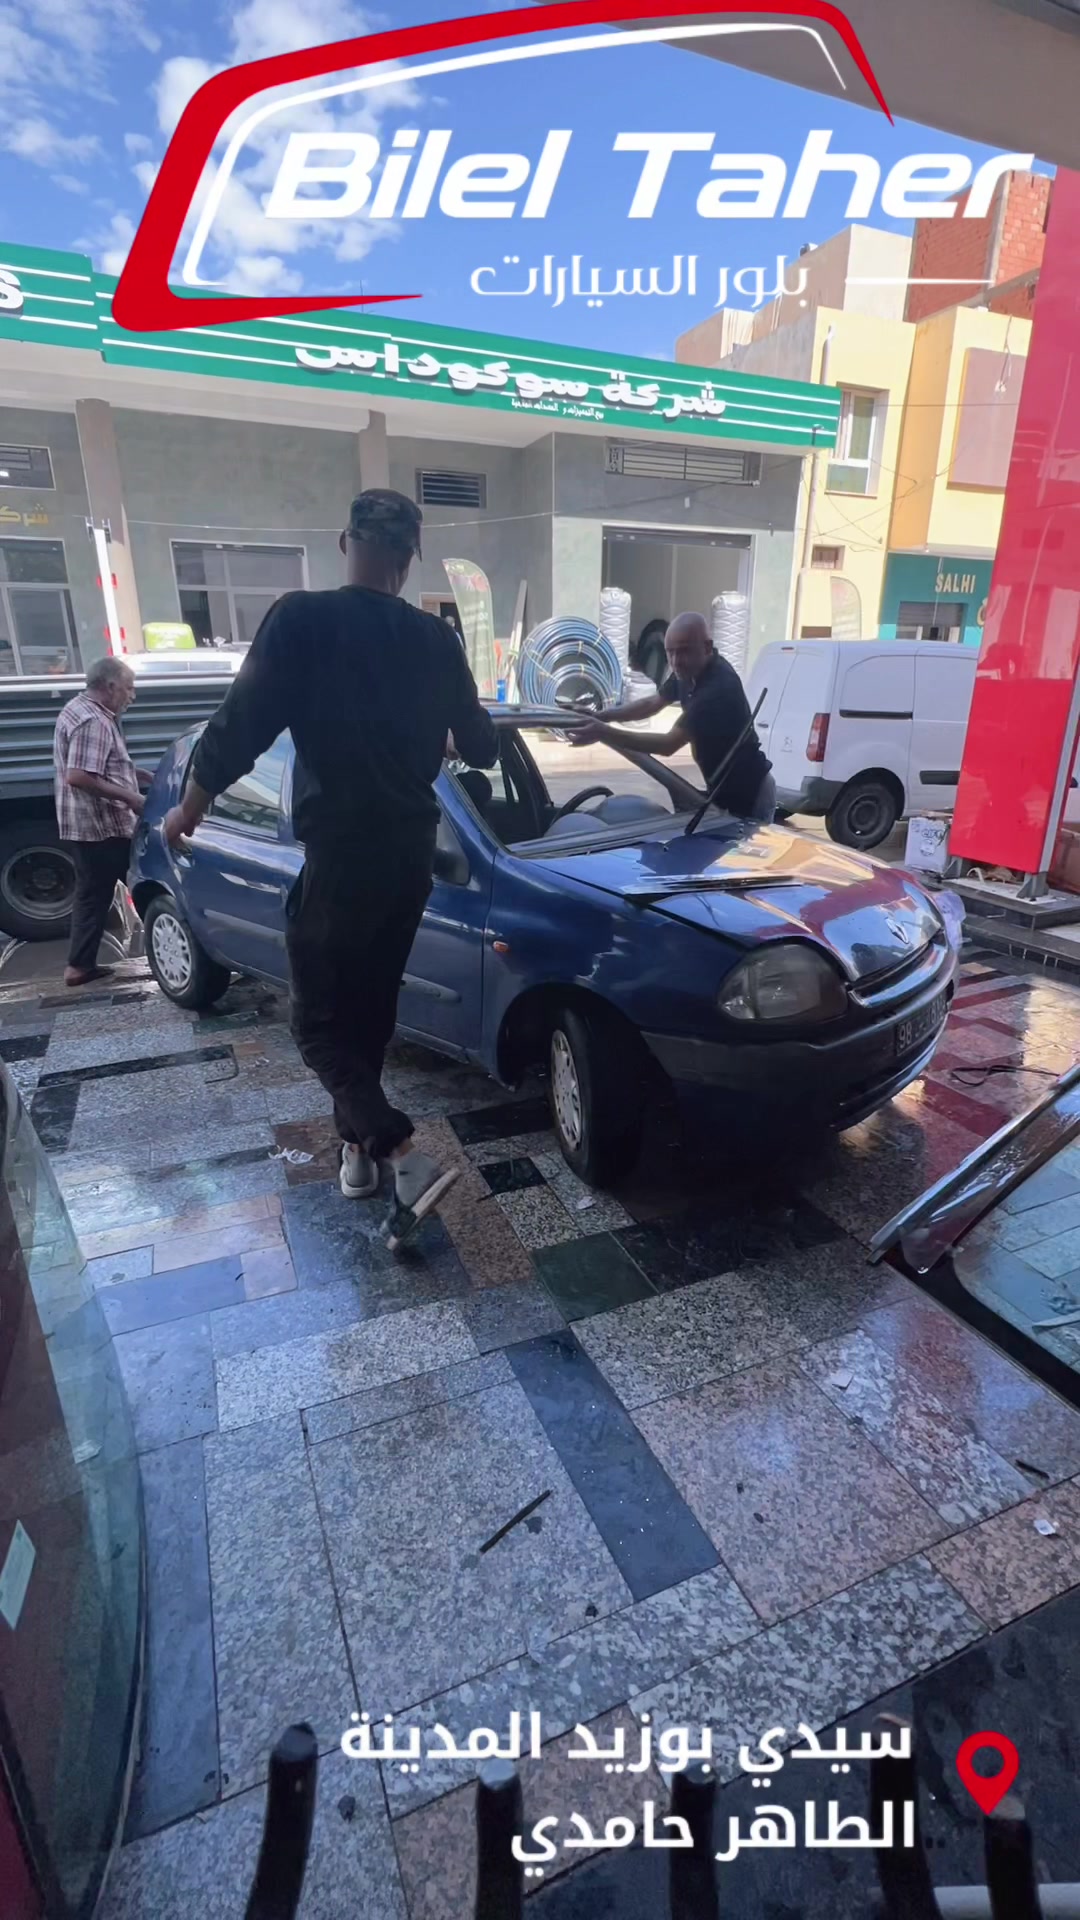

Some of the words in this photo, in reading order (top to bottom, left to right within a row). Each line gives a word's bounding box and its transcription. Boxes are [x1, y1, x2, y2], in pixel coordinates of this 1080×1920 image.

[296, 343, 590, 398] سوكوداس
[602, 369, 726, 417] شركة
[0, 503, 49, 527] شرك
[935, 573, 976, 594] SALHI
